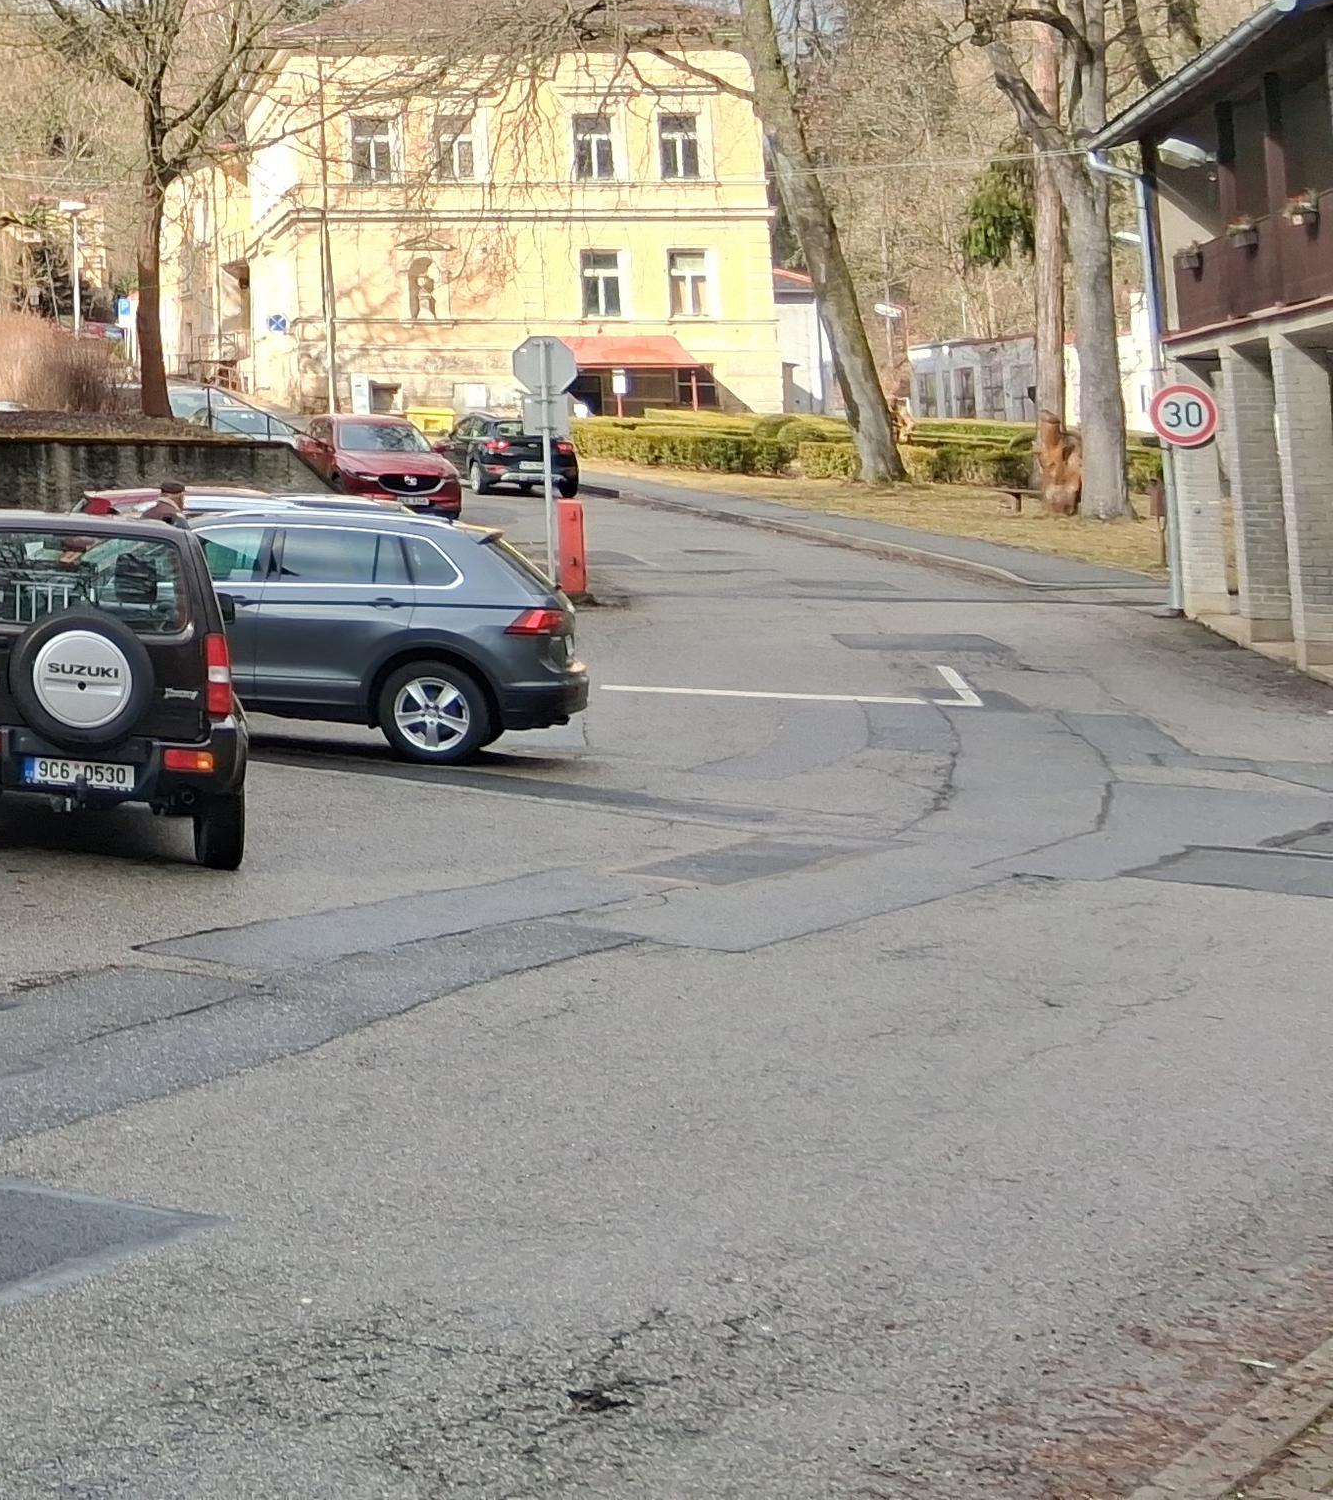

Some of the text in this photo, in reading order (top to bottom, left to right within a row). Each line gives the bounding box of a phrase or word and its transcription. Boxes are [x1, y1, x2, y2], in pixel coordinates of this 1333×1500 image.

[1163, 401, 1203, 428] 30
[47, 662, 119, 679] SUZUKI
[38, 760, 126, 784] 9C6 0530
